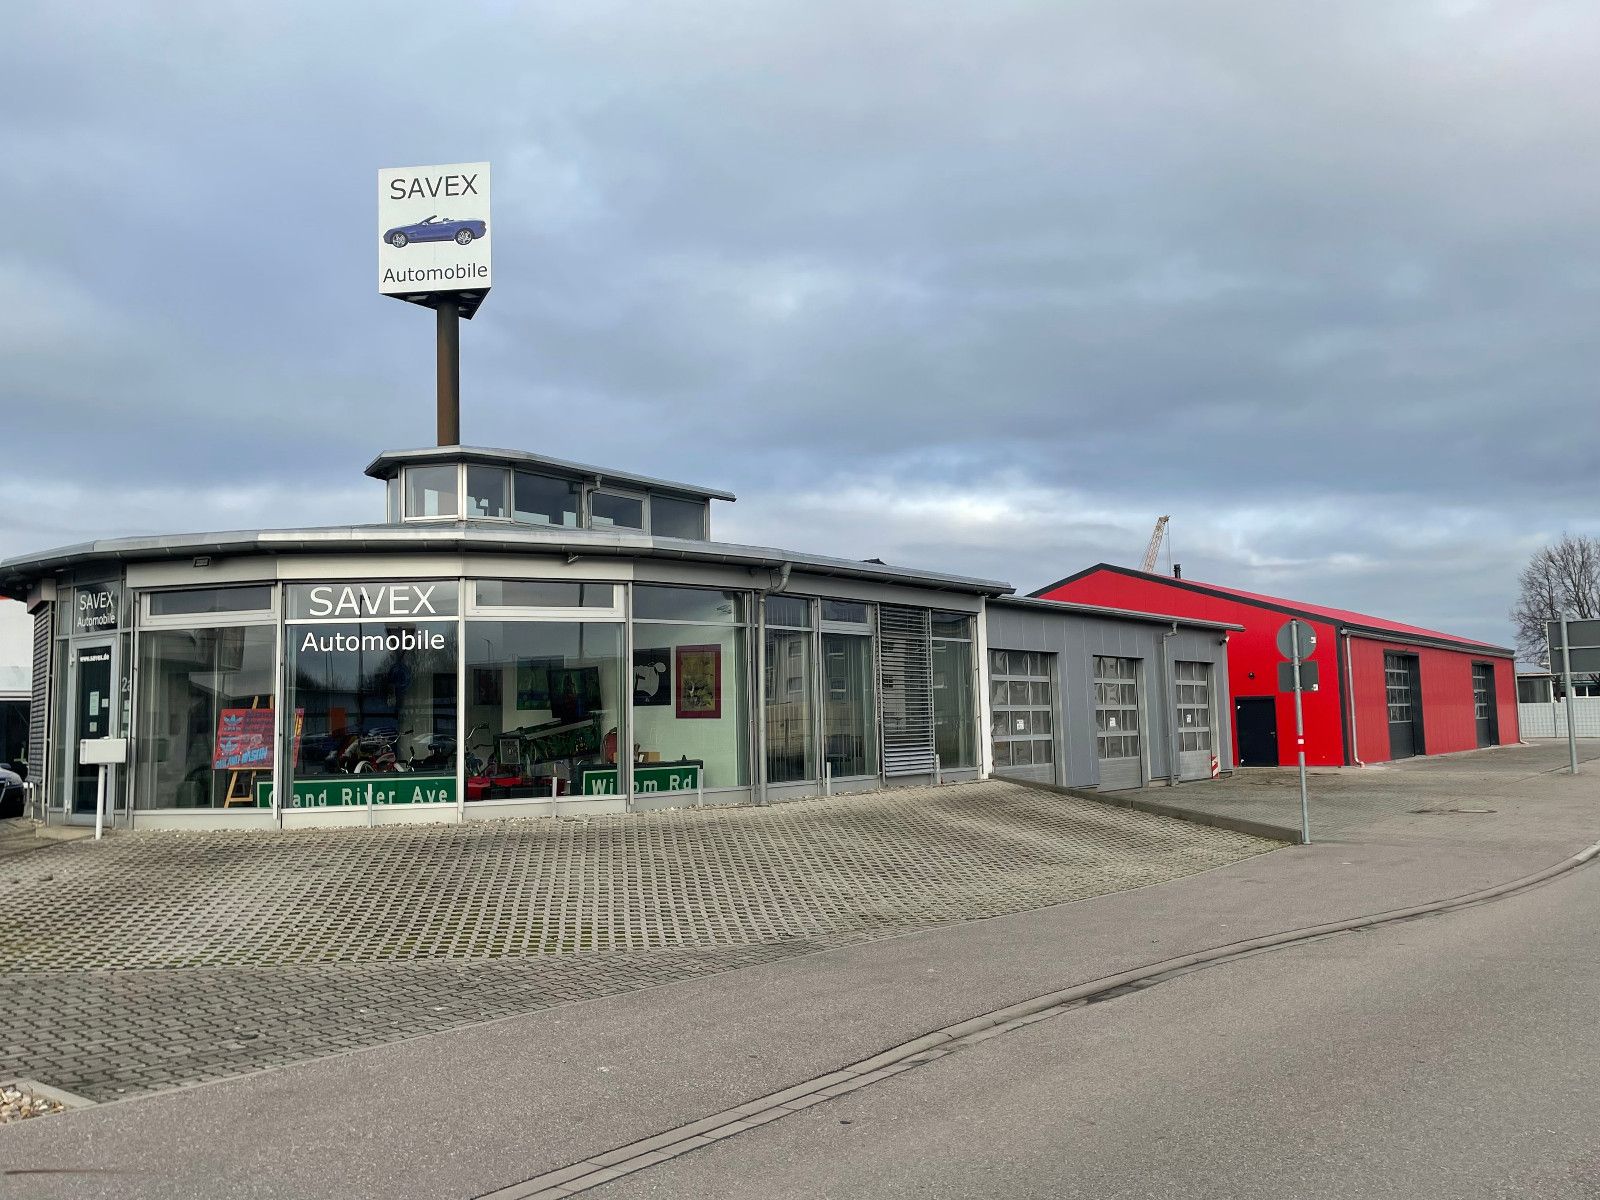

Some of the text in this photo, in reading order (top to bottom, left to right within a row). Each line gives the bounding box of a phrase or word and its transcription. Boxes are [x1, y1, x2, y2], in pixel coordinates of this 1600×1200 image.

[390, 173, 478, 200] SAVEX
[382, 262, 488, 283] Automobile
[79, 590, 114, 611] SAVEX
[309, 585, 437, 616] SAVEX
[76, 613, 116, 627] Automobile
[300, 629, 445, 652] Automobile
[411, 785, 448, 804] Ave
[591, 774, 693, 796] Wiom Rd
